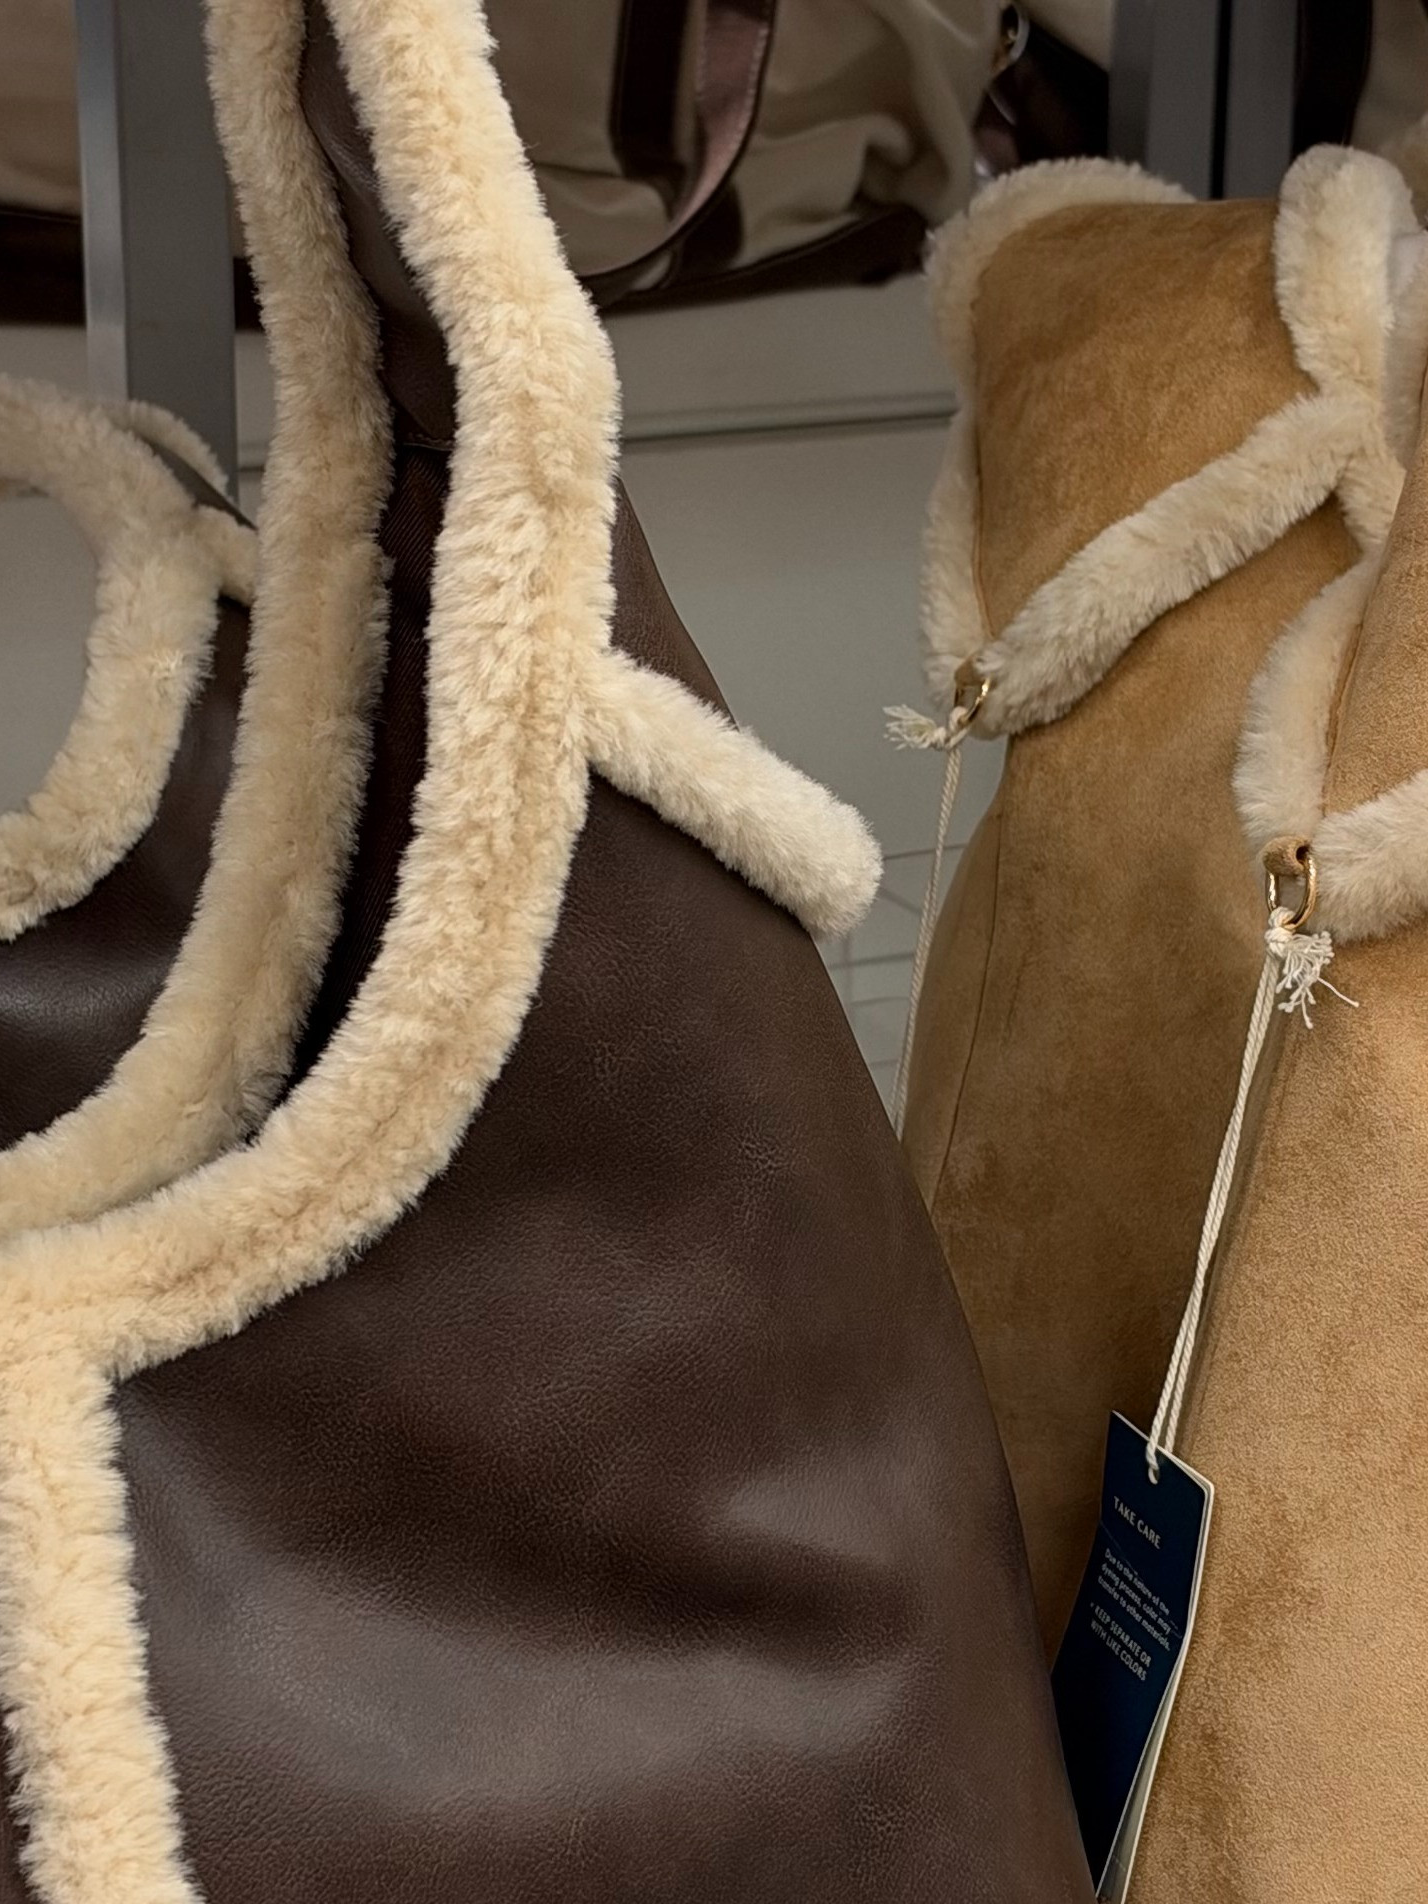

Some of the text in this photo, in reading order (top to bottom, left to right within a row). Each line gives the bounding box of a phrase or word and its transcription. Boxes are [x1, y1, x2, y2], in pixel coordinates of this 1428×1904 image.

[1113, 1495, 1161, 1550] TAKE CARE
[1105, 1548, 1116, 1565] Due
[1116, 1561, 1124, 1571] to
[1119, 1596, 1127, 1608] to
[1126, 1604, 1142, 1622] other
[1157, 1617, 1171, 1635] may
[1091, 1620, 1147, 1681] WITH LIKE COLORS
[1095, 1606, 1152, 1667] KEEP SEPARATE OR
